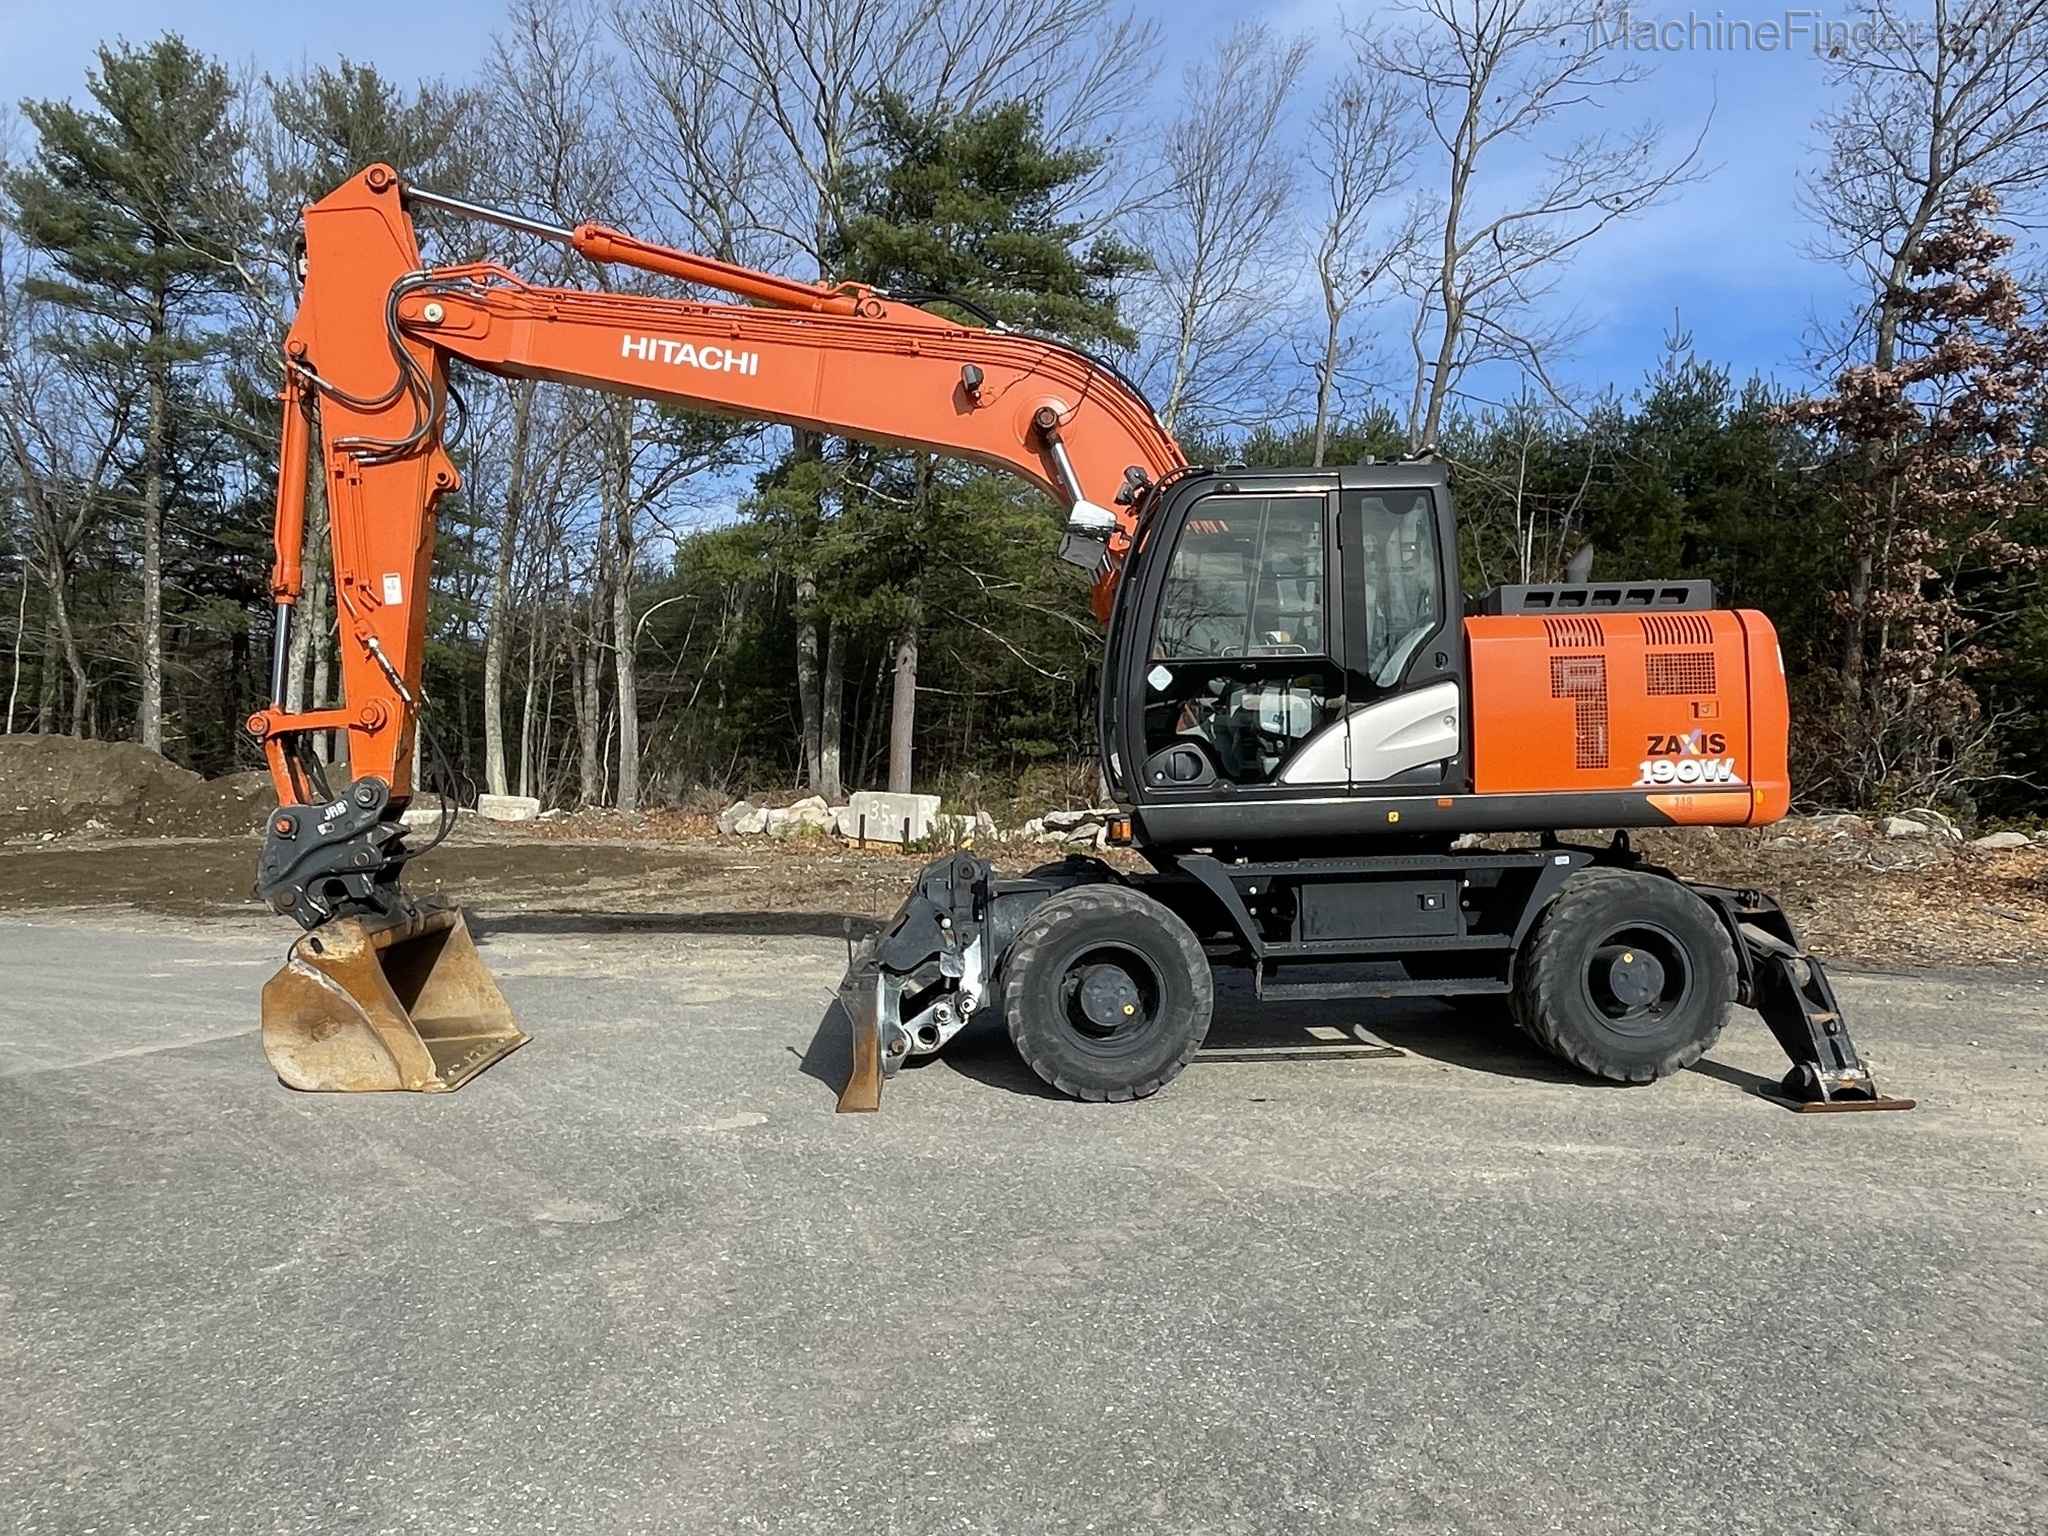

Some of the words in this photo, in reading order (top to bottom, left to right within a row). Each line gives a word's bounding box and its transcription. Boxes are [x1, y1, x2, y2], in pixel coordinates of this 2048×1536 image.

[621, 334, 759, 376] HITACHI
[1647, 728, 1726, 756] ZAXIS
[1639, 758, 1735, 784] 190W
